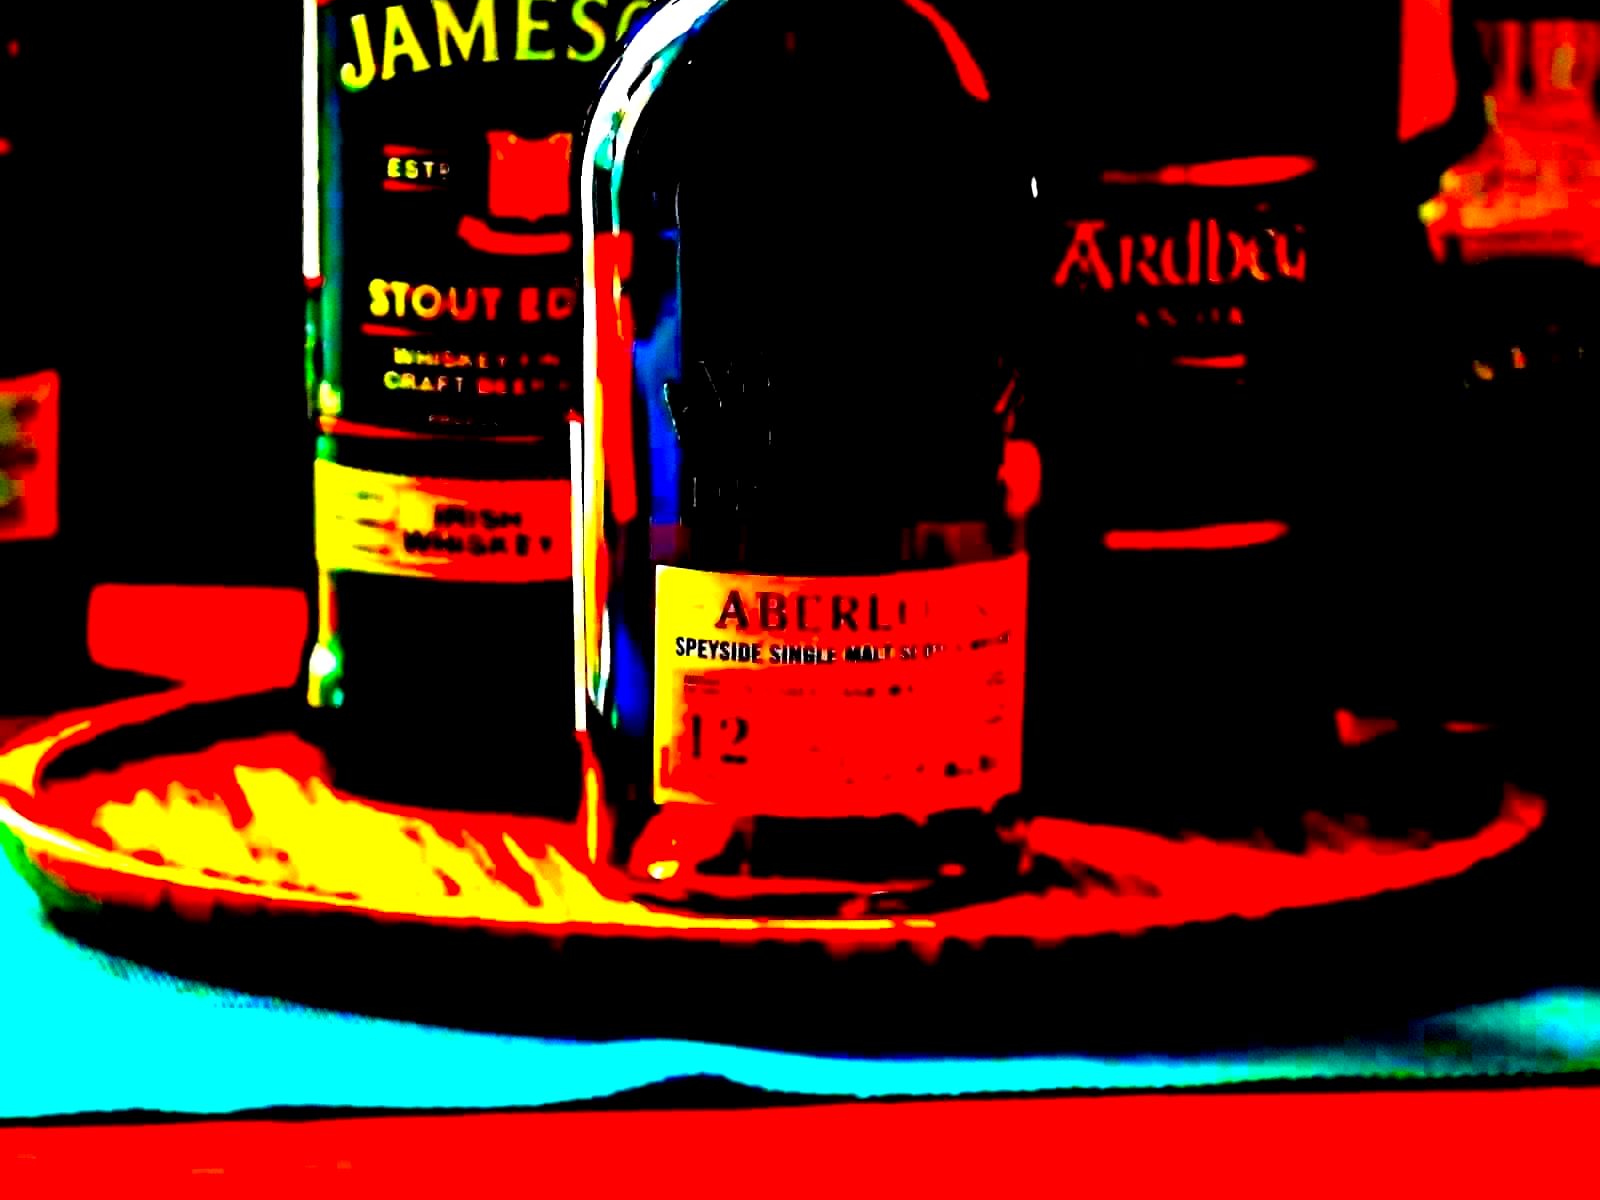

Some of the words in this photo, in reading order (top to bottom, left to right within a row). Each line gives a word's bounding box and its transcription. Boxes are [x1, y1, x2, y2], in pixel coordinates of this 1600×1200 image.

[368, 278, 504, 322] STOUT
[383, 370, 466, 394] CRAFT
[714, 590, 987, 633] ABERL
[675, 637, 762, 664] SPEYSIDE
[768, 644, 837, 665] SINGLE
